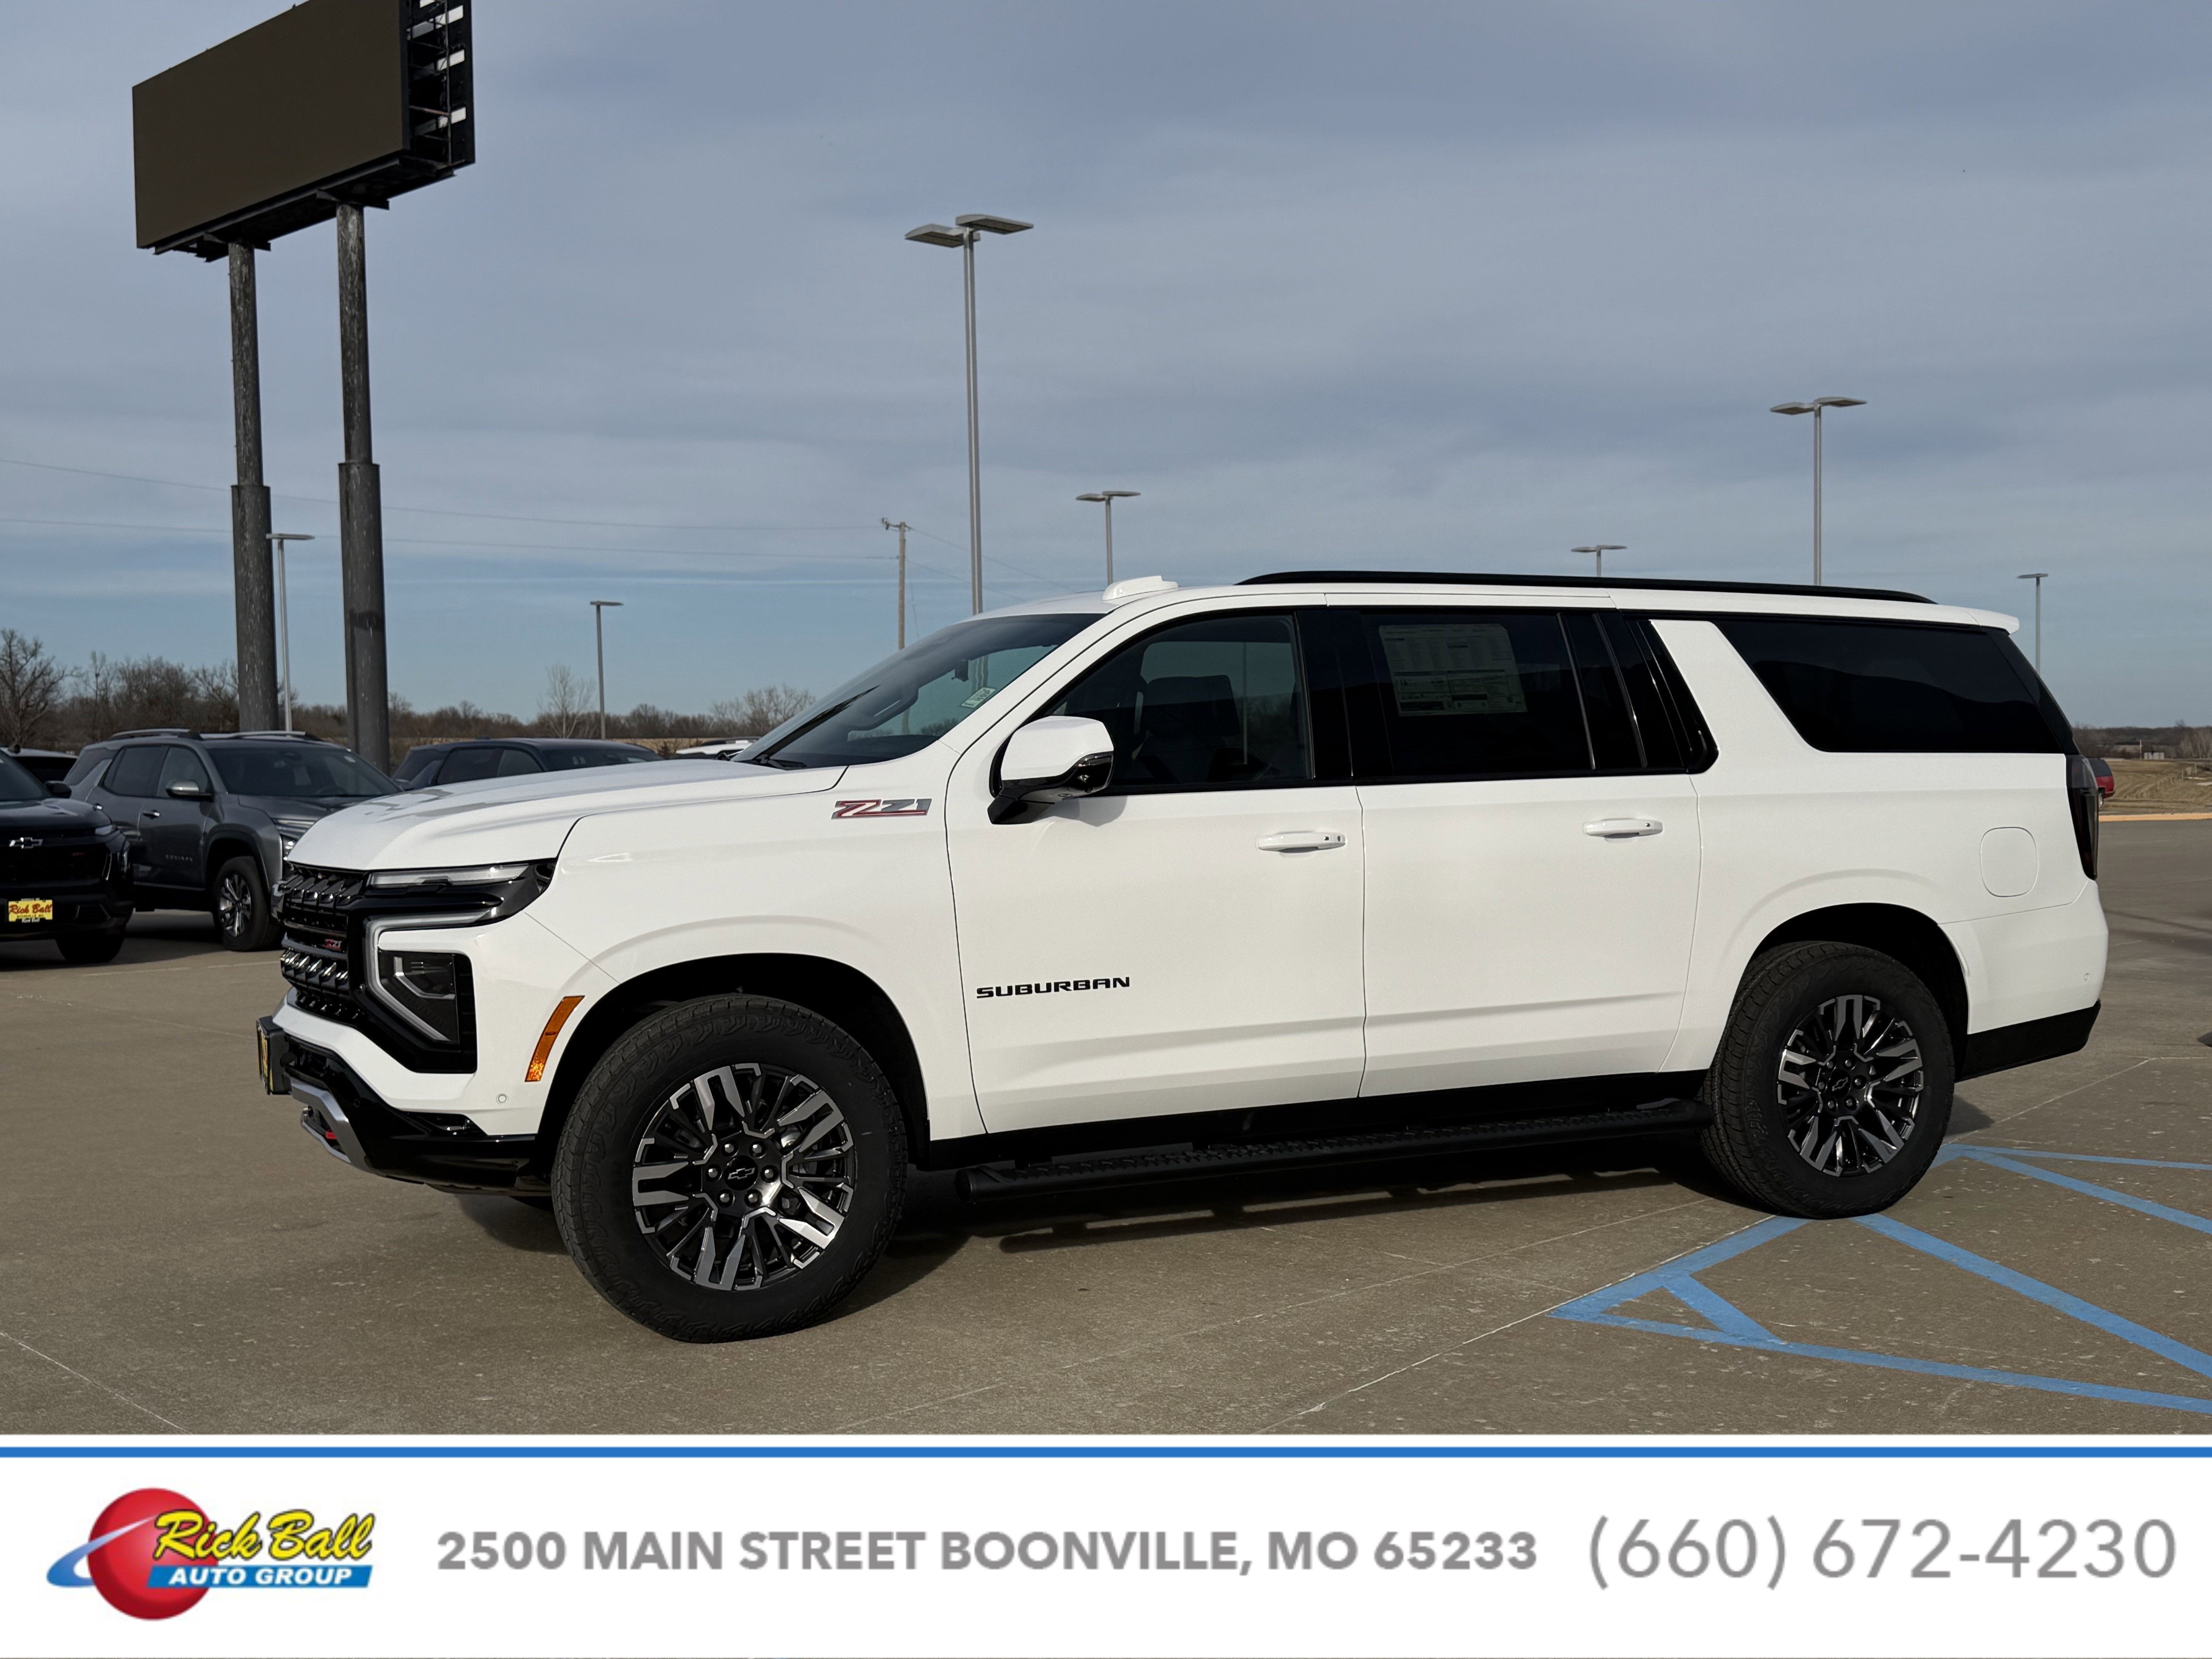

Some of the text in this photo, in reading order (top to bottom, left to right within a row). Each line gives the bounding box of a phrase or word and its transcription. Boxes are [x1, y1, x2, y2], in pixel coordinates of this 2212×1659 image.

[831, 799, 932, 819] Z71
[9, 903, 52, 914] Rick Ball
[977, 977, 1130, 999] SUBURBAN
